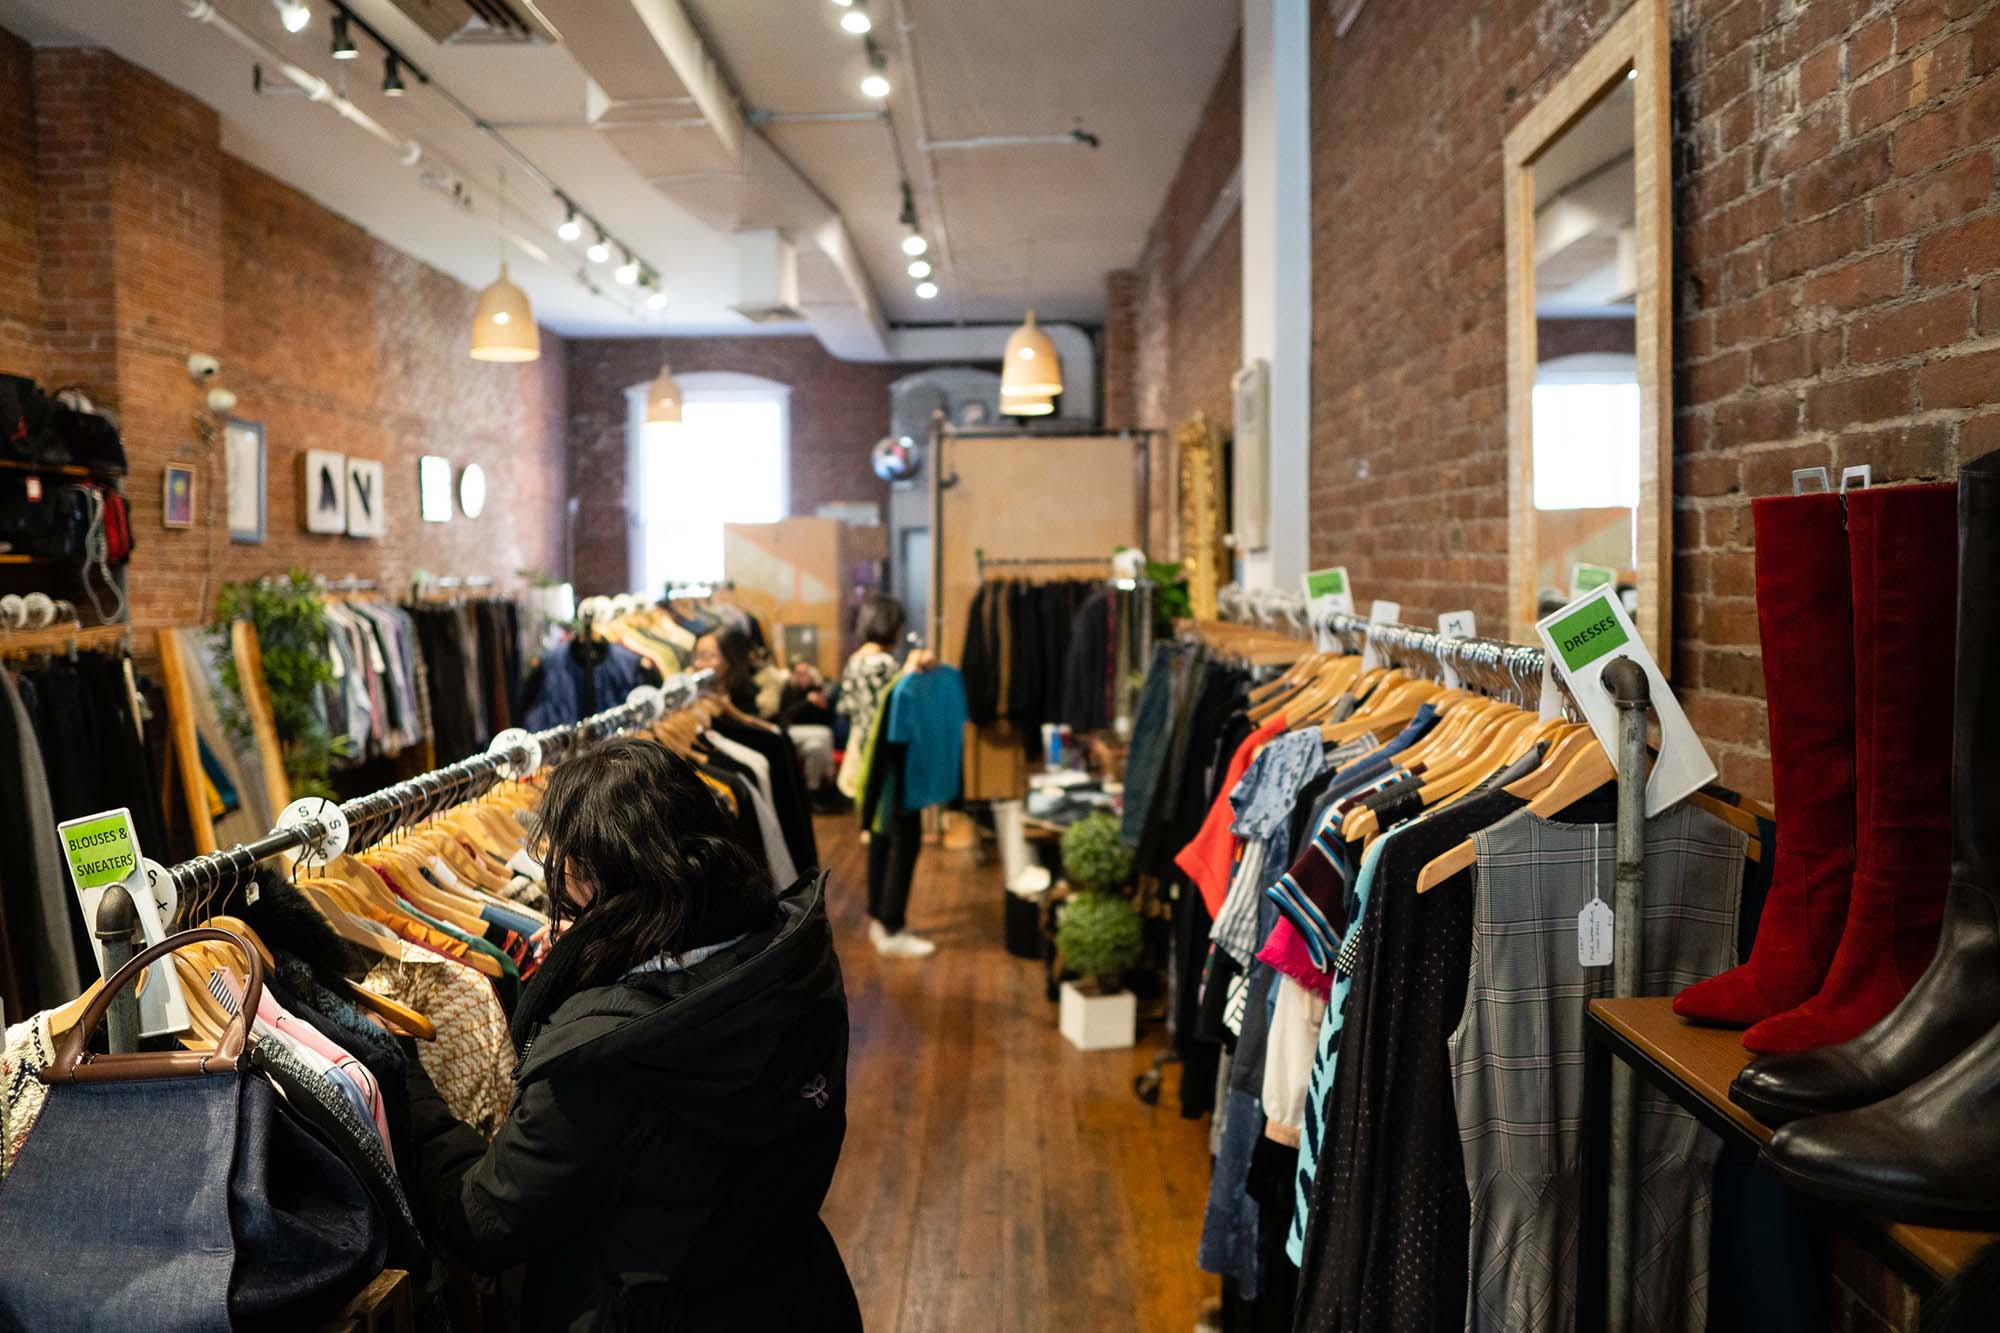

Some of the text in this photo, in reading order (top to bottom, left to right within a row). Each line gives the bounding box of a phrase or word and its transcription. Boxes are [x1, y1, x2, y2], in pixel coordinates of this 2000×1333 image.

[1563, 616, 1616, 652] DRESSES
[298, 805, 310, 818] S
[68, 827, 128, 852] BLOUSES &
[76, 854, 133, 877] SWEATERS
